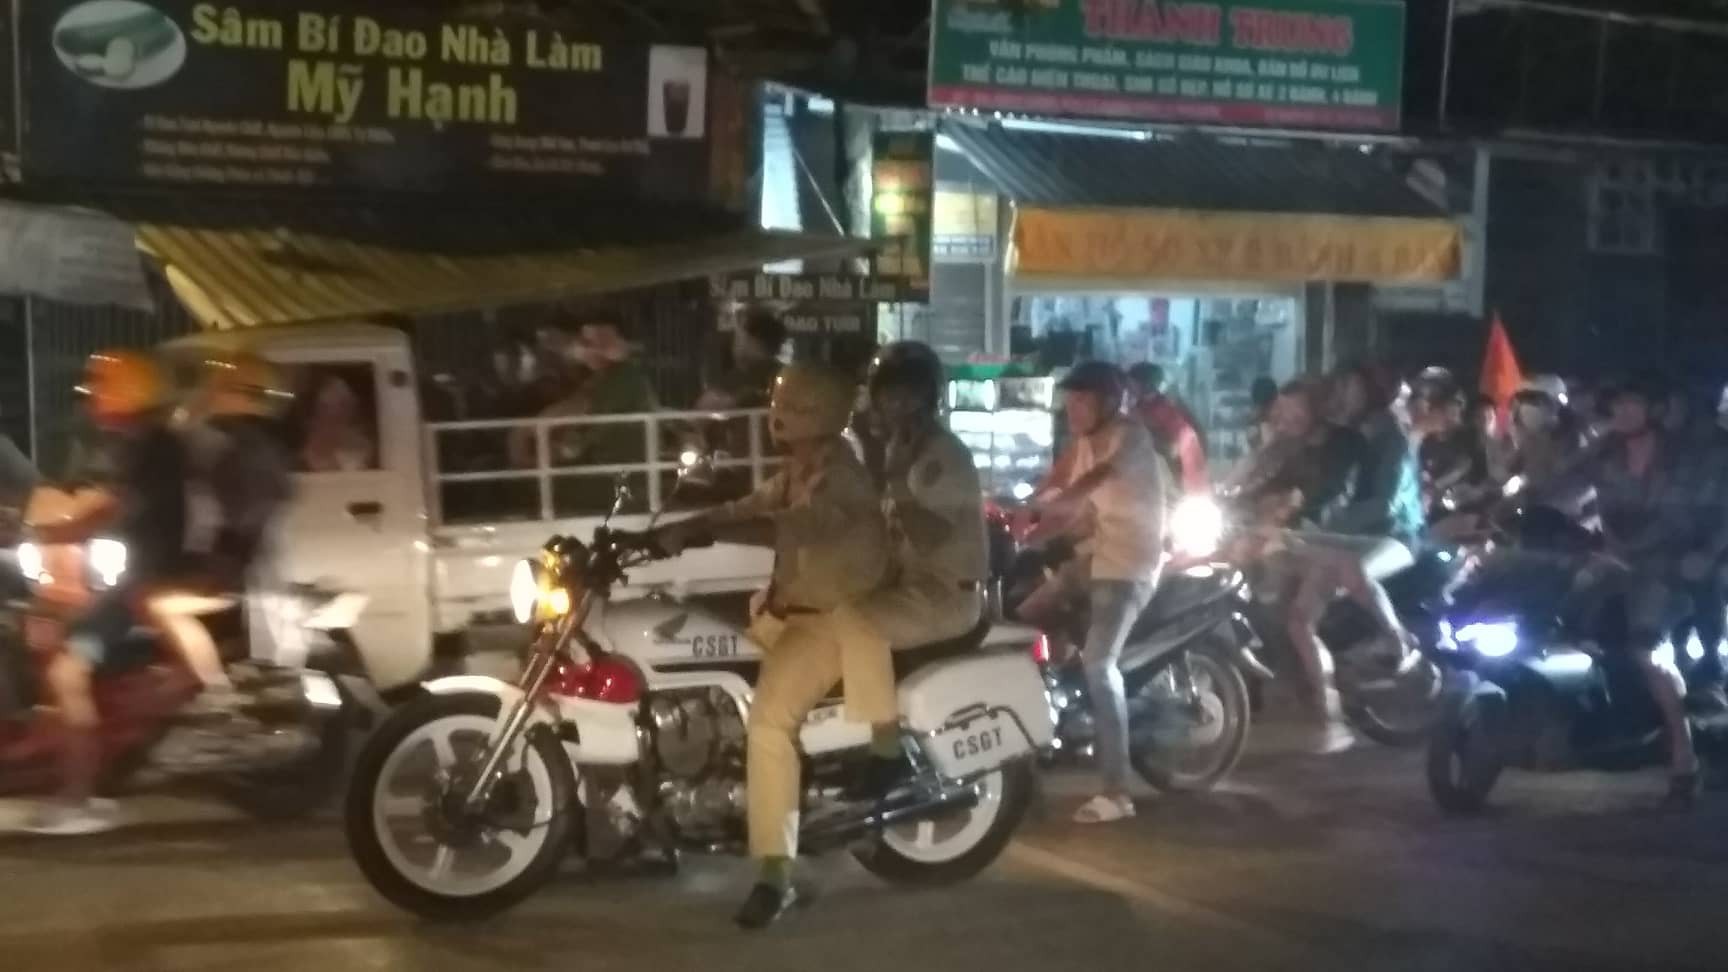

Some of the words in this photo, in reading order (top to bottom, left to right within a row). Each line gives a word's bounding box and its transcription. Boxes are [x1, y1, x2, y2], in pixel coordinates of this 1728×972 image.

[190, 2, 283, 49] Sâm
[297, 10, 342, 53] Bí
[353, 16, 428, 58] Đao
[441, 23, 511, 65] Nhà
[525, 29, 604, 71] Làm
[286, 58, 366, 124] Mỹ
[387, 65, 519, 130] Hạnh
[692, 635, 738, 657] CSGT
[952, 726, 1003, 760] CSGT
